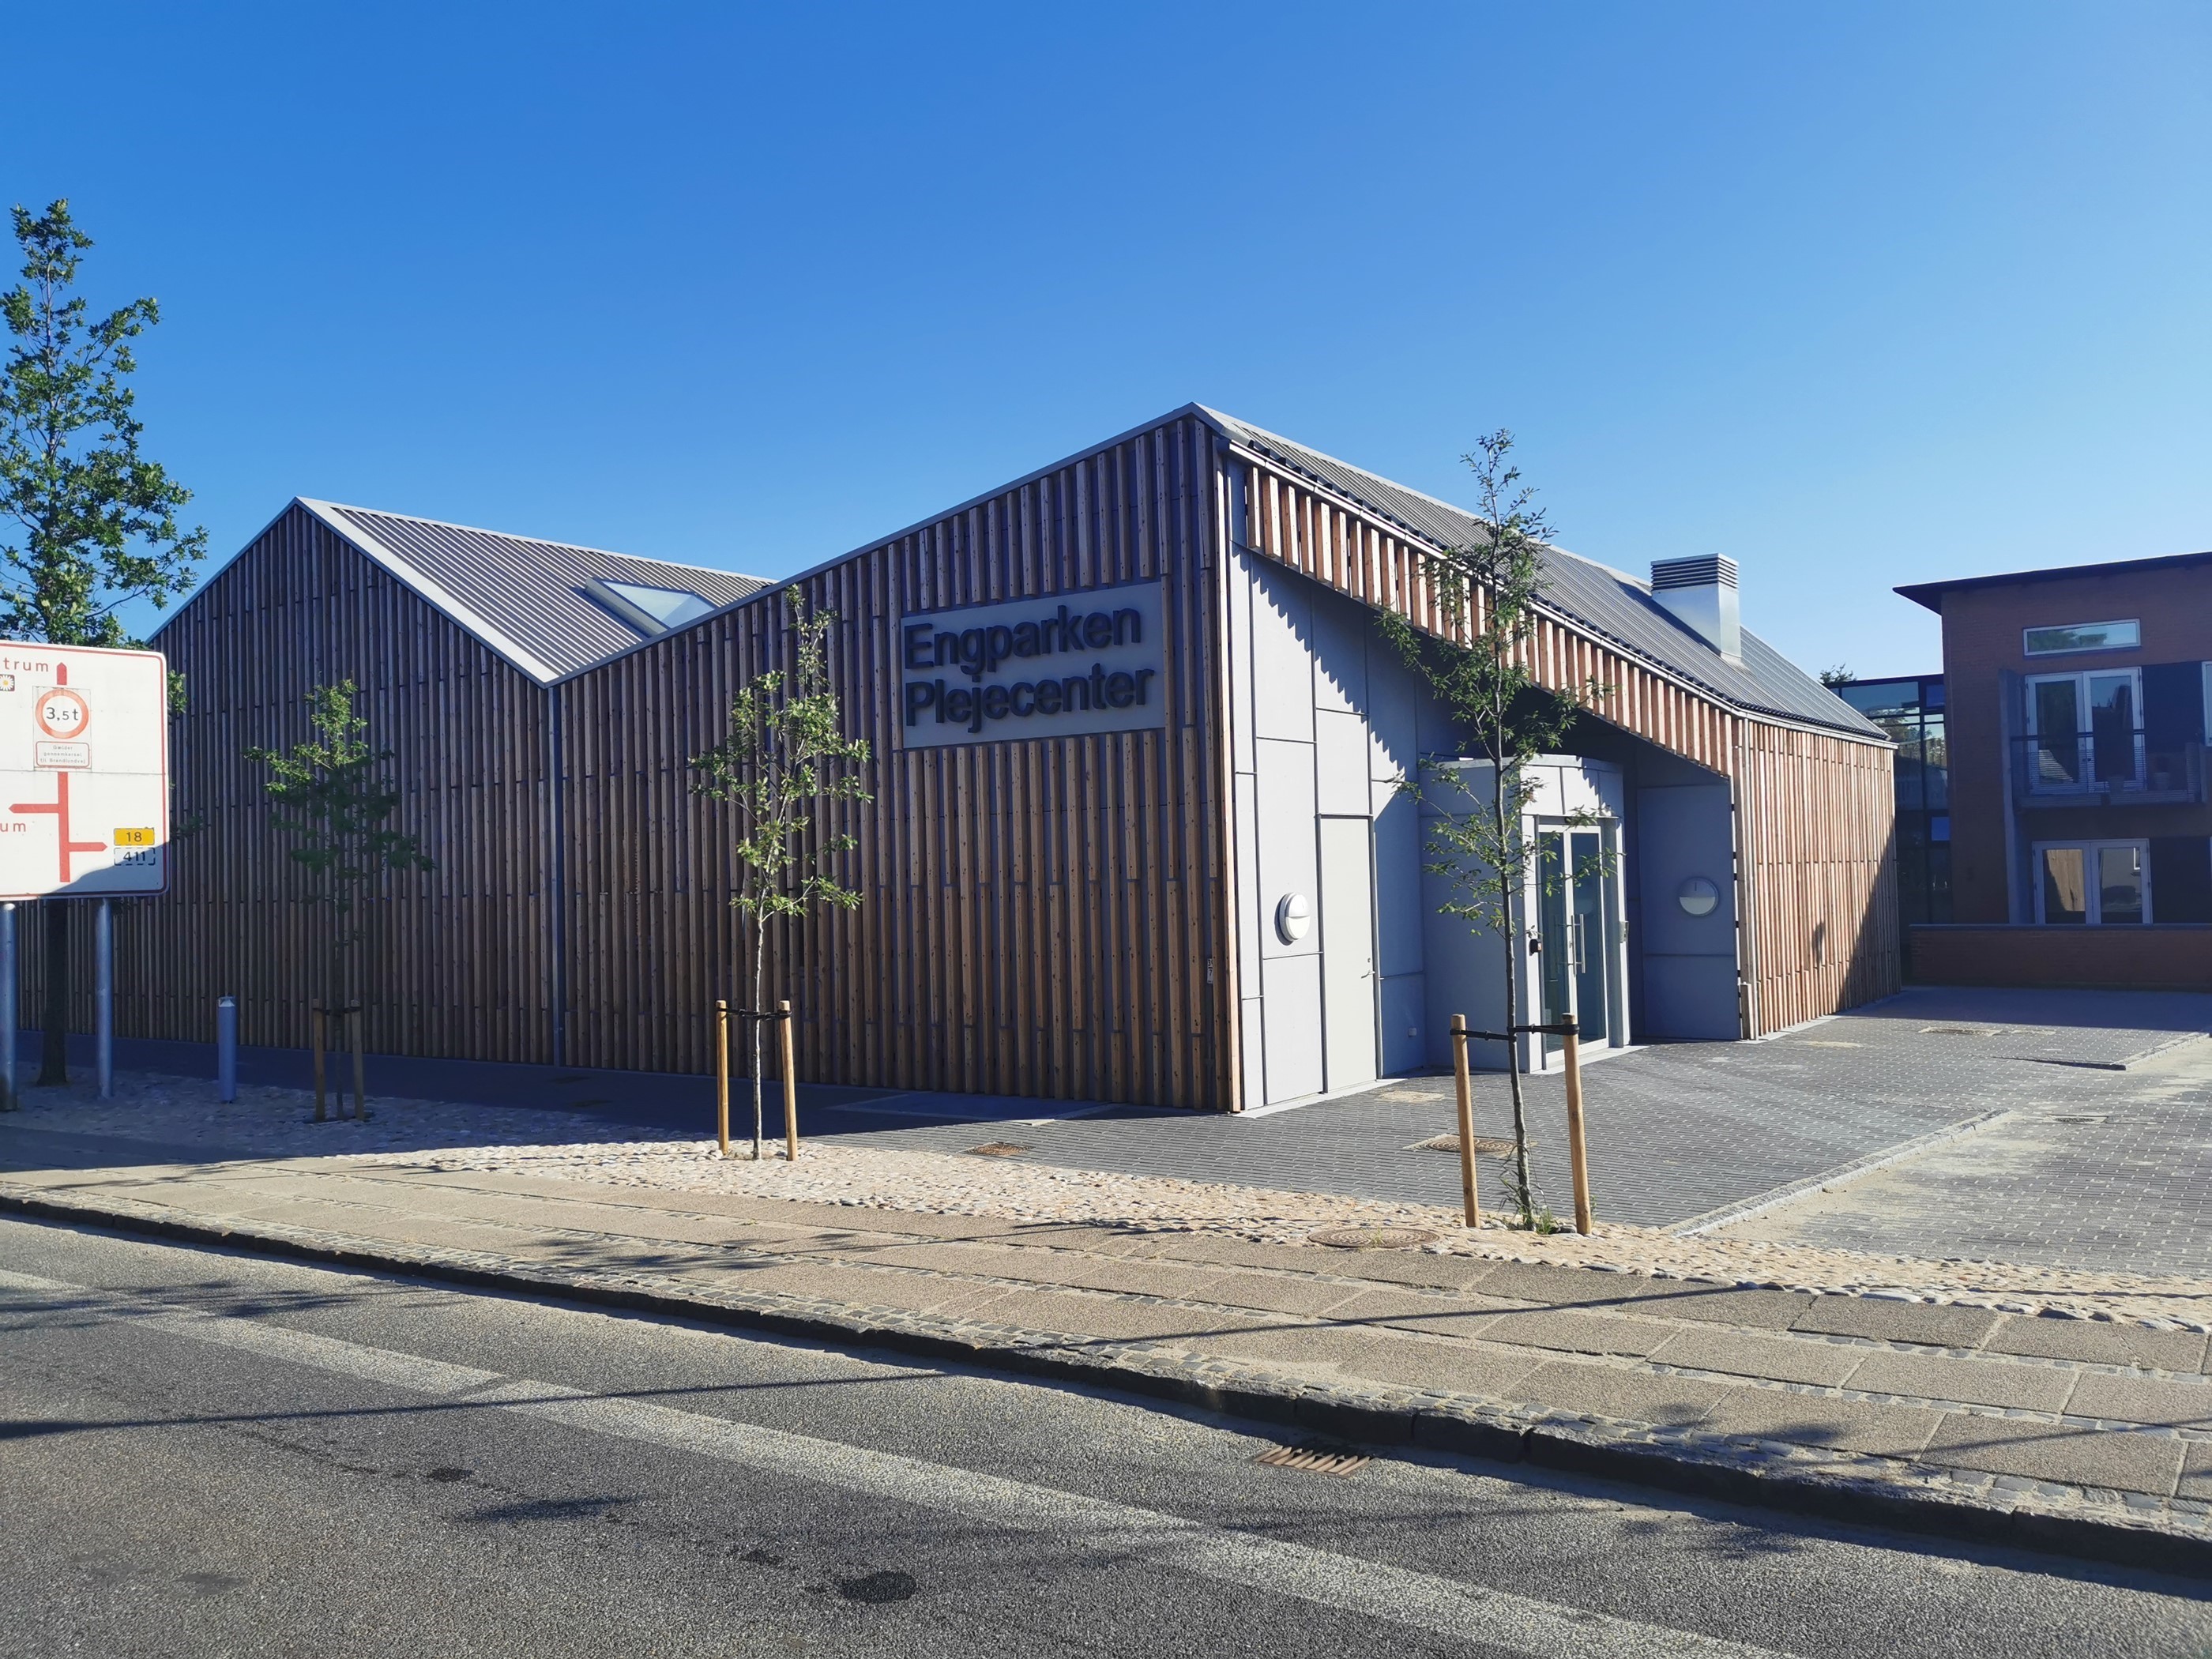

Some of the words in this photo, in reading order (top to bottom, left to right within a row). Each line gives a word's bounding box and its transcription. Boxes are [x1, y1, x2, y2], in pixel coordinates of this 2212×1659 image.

[904, 604, 1141, 675] Engparken
[2, 656, 49, 672] trum
[905, 663, 1155, 733] Plejecenter
[126, 831, 142, 842] 18
[122, 851, 145, 861] 411
